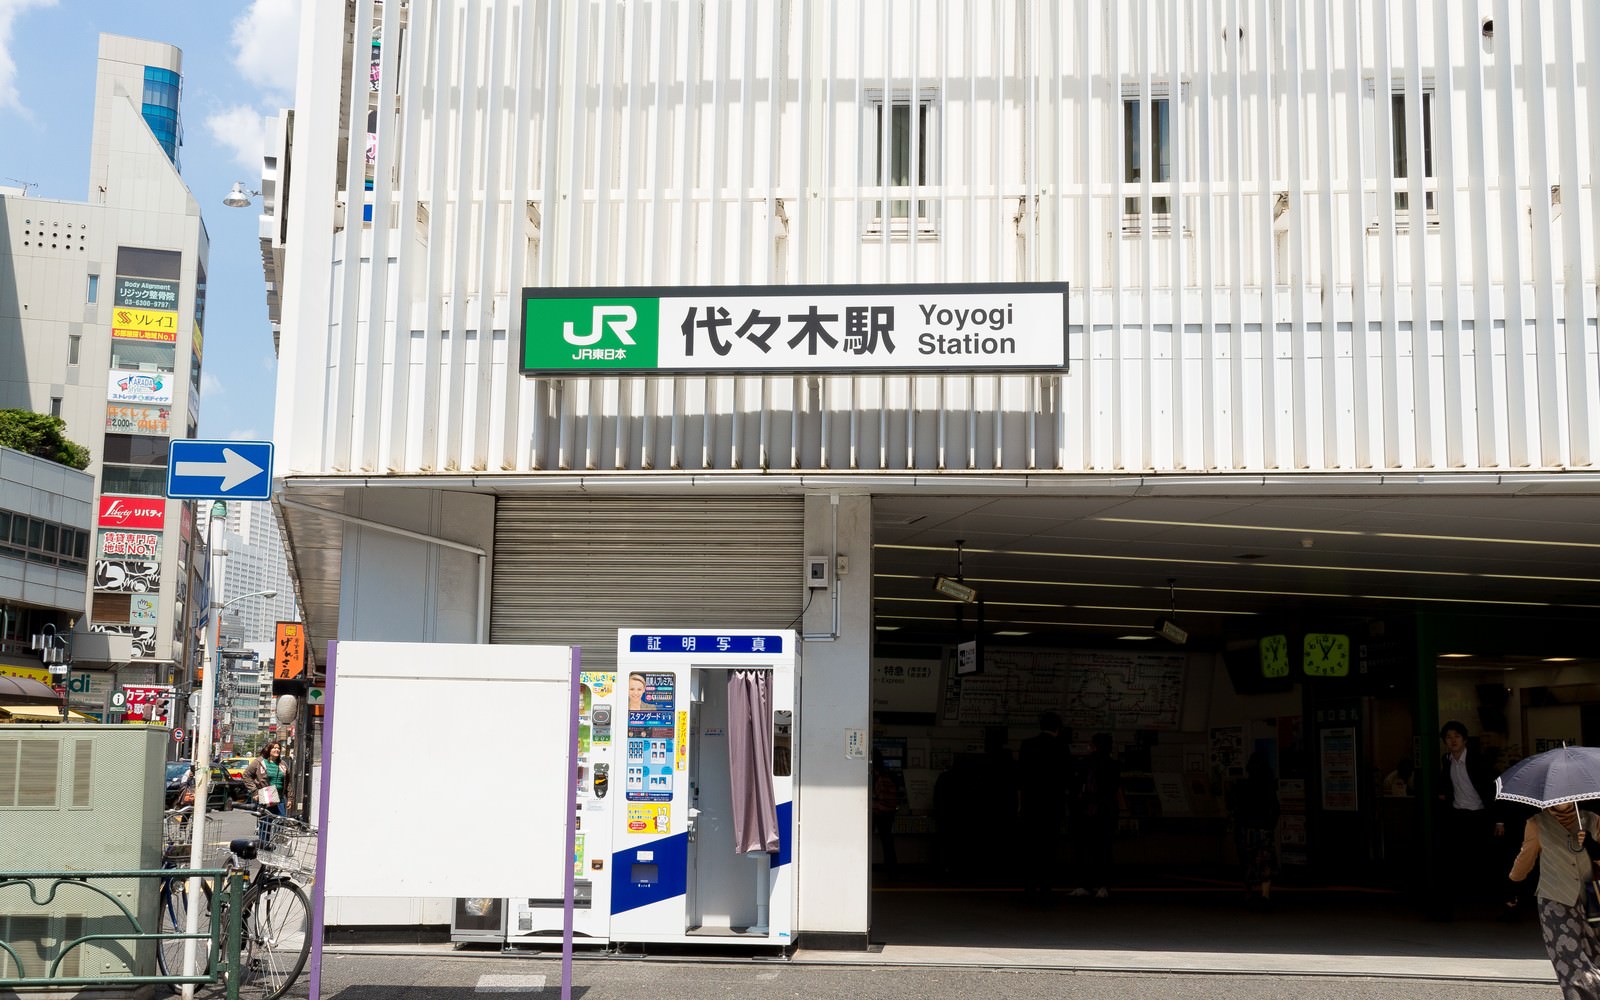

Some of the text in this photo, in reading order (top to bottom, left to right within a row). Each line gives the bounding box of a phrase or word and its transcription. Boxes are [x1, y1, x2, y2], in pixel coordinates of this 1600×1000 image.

[918, 303, 1013, 331] Yoyogi
[563, 305, 638, 347] JR
[681, 305, 896, 357] 代々木駅
[918, 332, 1016, 355] Station
[572, 348, 627, 361] JR東日本
[101, 500, 132, 524] Liberty
[134, 509, 163, 518] リバティ
[104, 533, 157, 545] 賃貸専門店
[103, 543, 156, 555] 地域 NO.1
[647, 636, 767, 652] 証明写真
[630, 712, 661, 720] スタンダード
